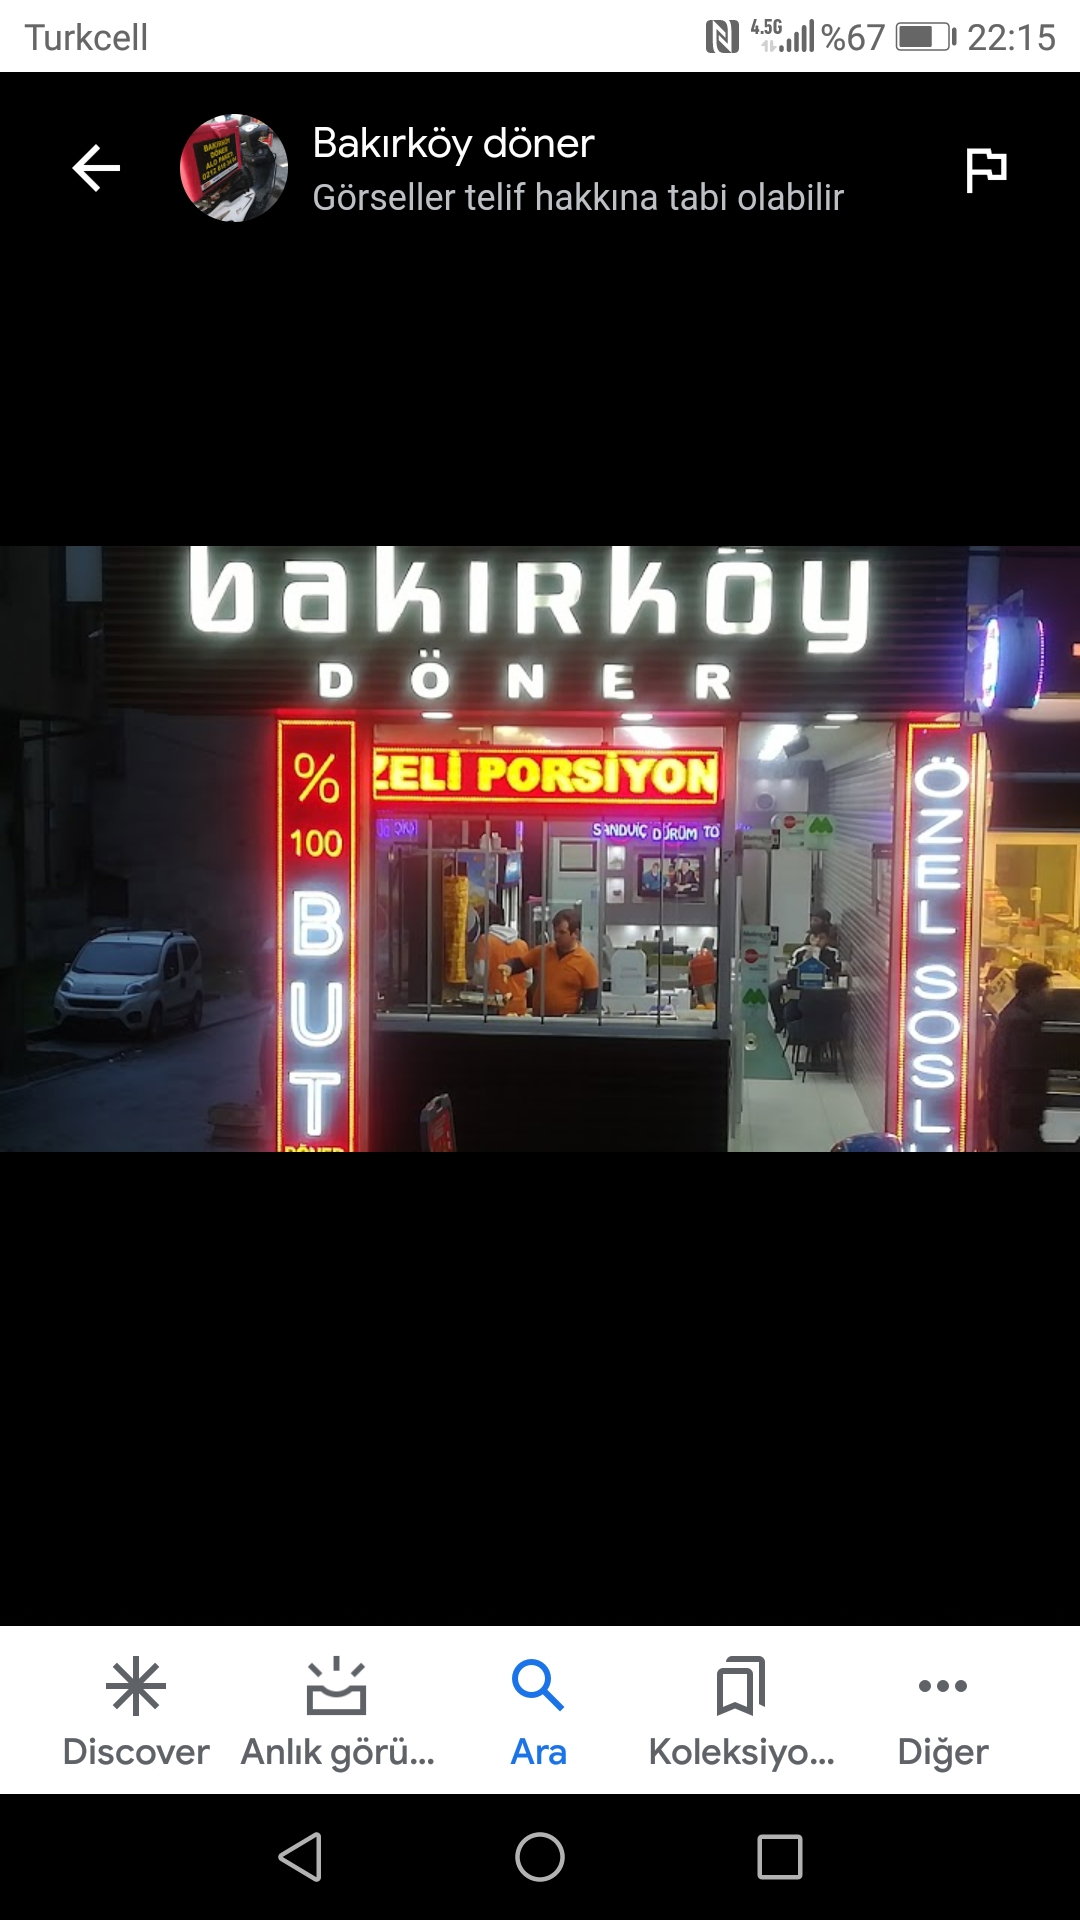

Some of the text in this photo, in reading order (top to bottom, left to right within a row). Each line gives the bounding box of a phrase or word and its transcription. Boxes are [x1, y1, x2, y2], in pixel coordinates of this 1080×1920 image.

[319, 649, 731, 700] DÖNER
[294, 752, 340, 804] %
[477, 752, 719, 793] PORSİYON
[290, 829, 343, 858] 100
[913, 756, 970, 935] ÖZEL
[289, 890, 344, 1136] BUT
